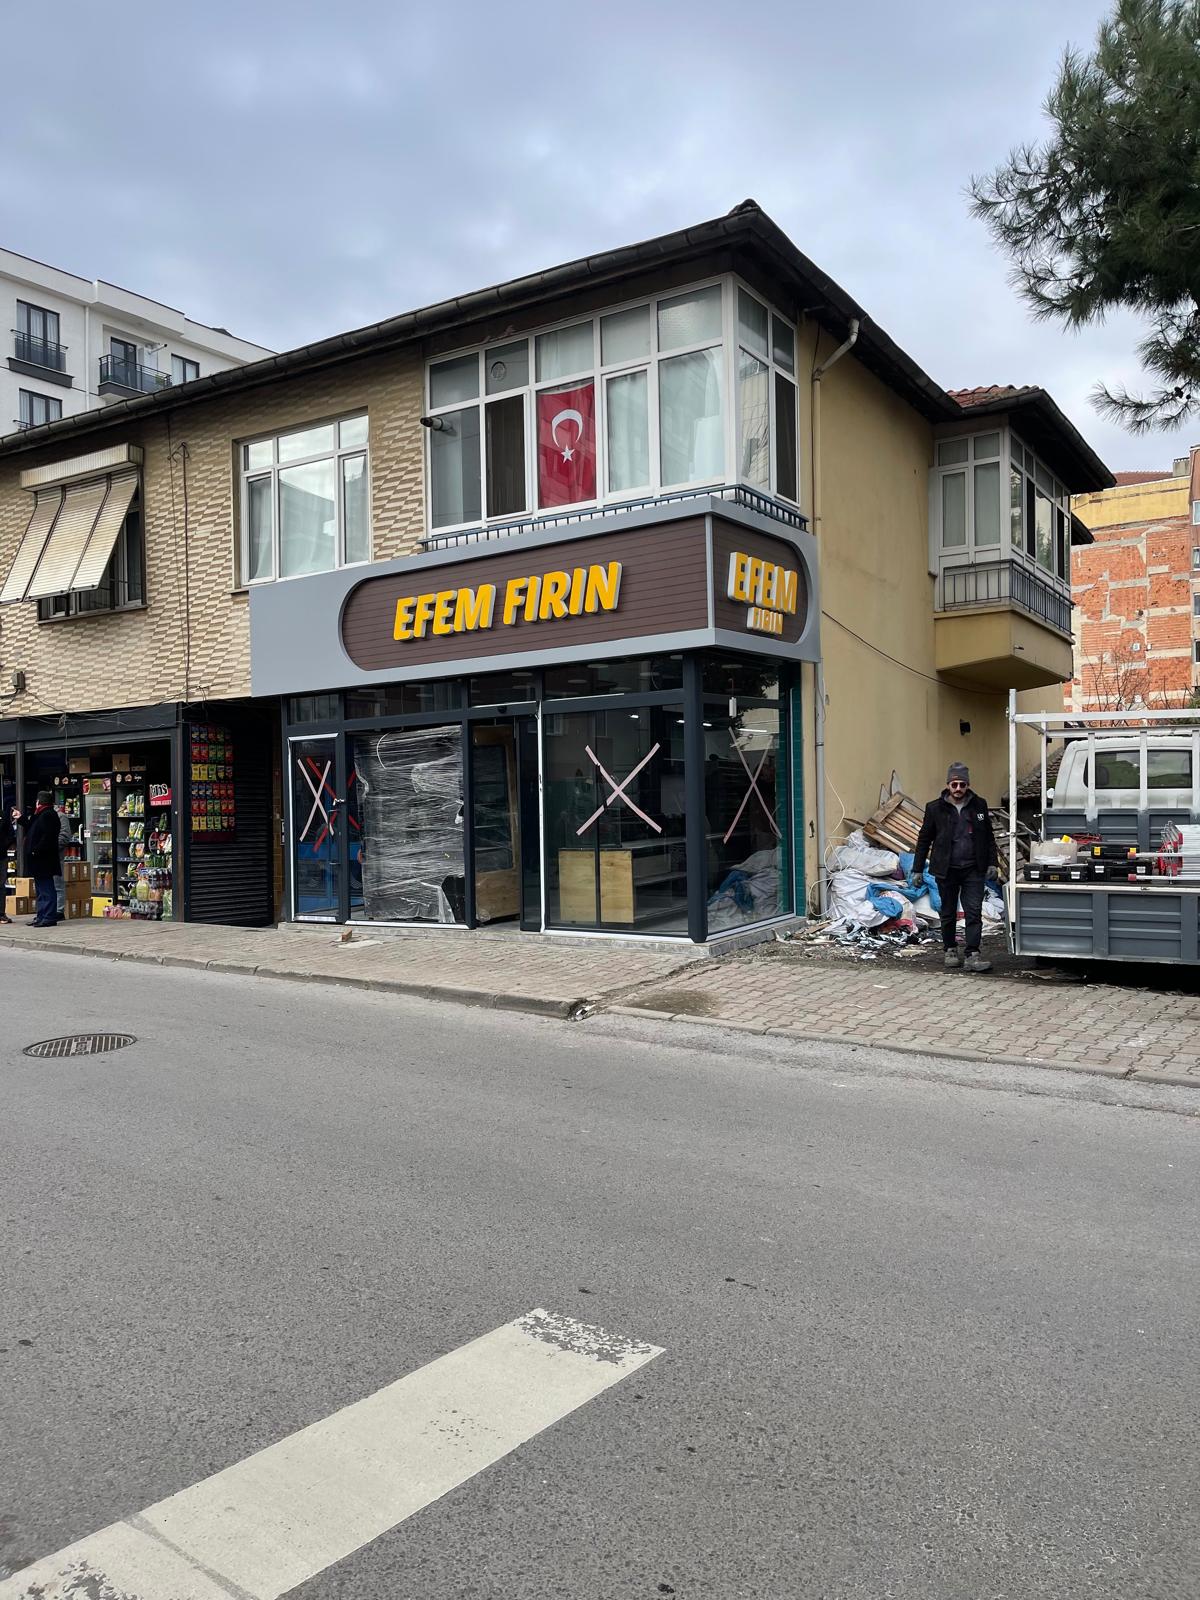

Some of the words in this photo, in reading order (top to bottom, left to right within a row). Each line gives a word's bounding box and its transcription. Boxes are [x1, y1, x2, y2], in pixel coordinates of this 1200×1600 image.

[394, 584, 496, 641] EFEM
[503, 562, 622, 625] FIRIN
[728, 552, 797, 614] EFEM
